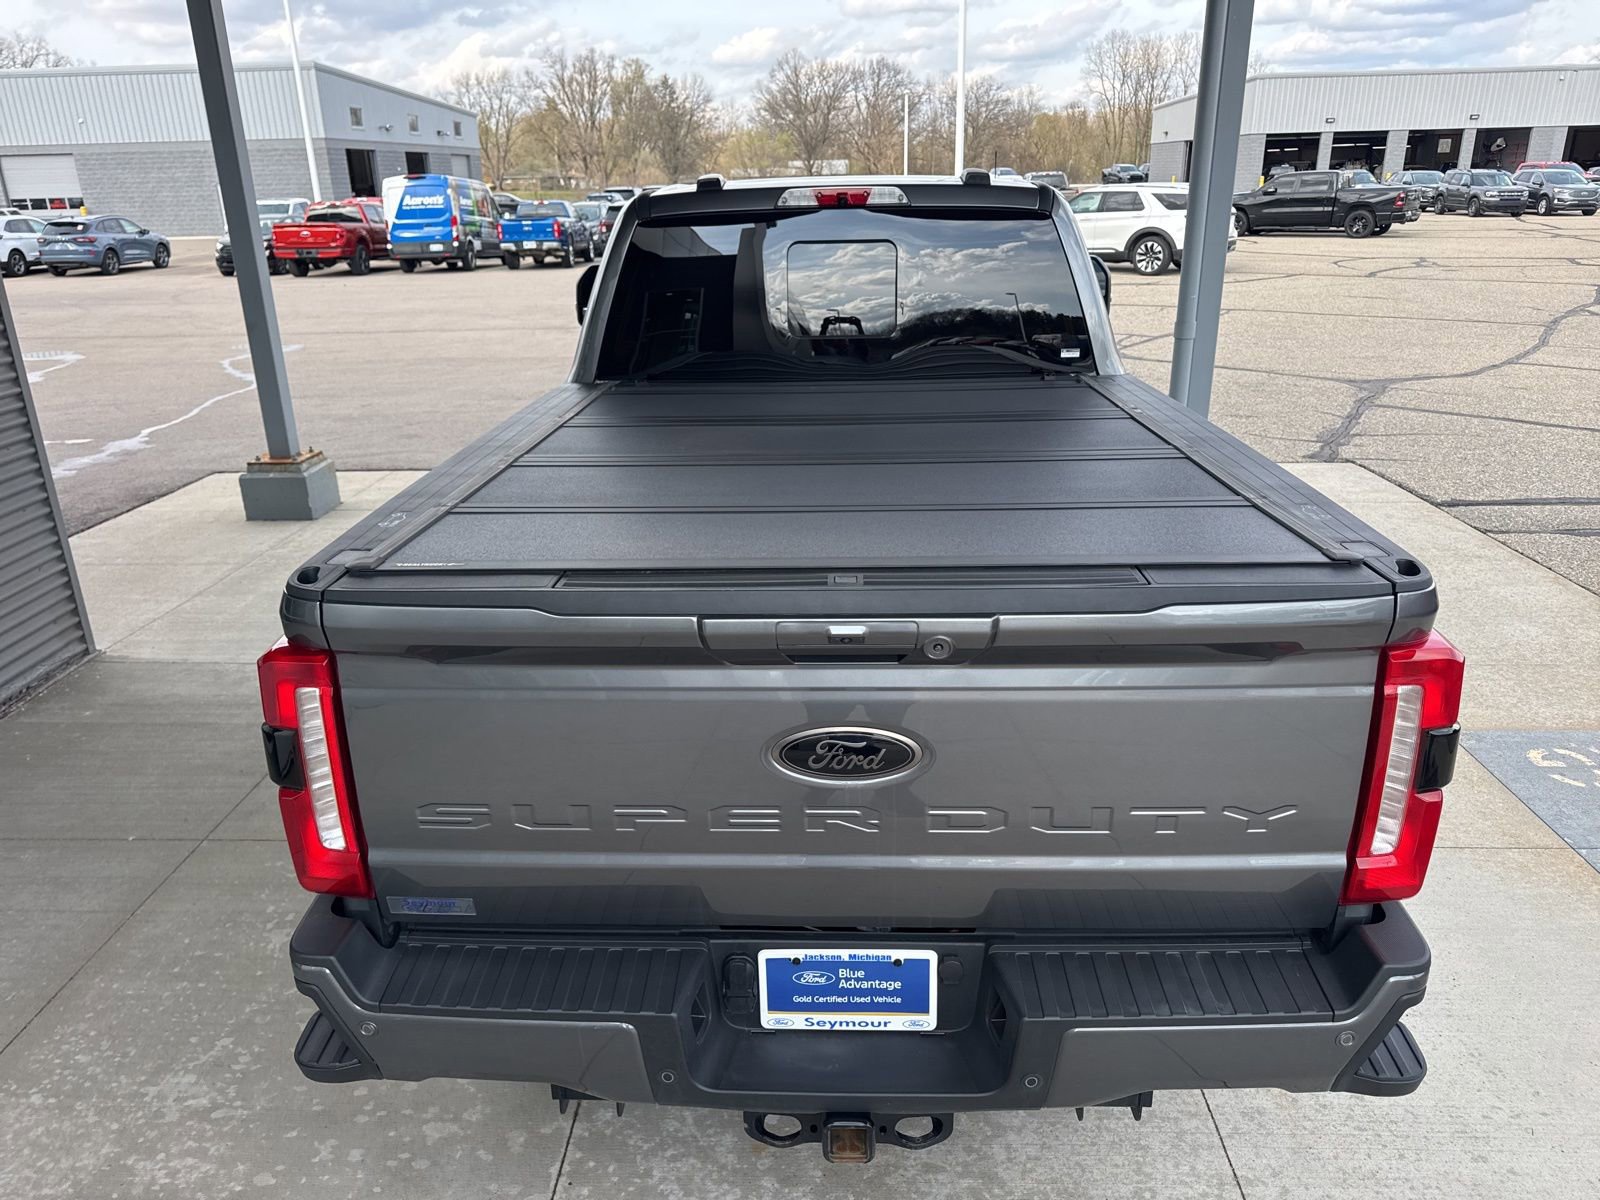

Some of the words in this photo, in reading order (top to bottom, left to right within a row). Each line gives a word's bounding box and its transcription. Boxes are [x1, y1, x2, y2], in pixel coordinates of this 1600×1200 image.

[807, 739, 887, 770] Ford
[416, 802, 881, 833] SUPER
[927, 803, 1298, 834] DUTY
[802, 953, 845, 962] Jackson,
[848, 953, 892, 962] Michigan
[800, 972, 827, 984] Ford
[838, 968, 865, 978] Blue
[838, 979, 902, 991] Advantage
[793, 995, 812, 1003] Gold
[813, 995, 848, 1003] Certified
[849, 995, 871, 1003] Used
[873, 996, 902, 1004] Vehicle
[804, 1017, 892, 1030] Seymour
